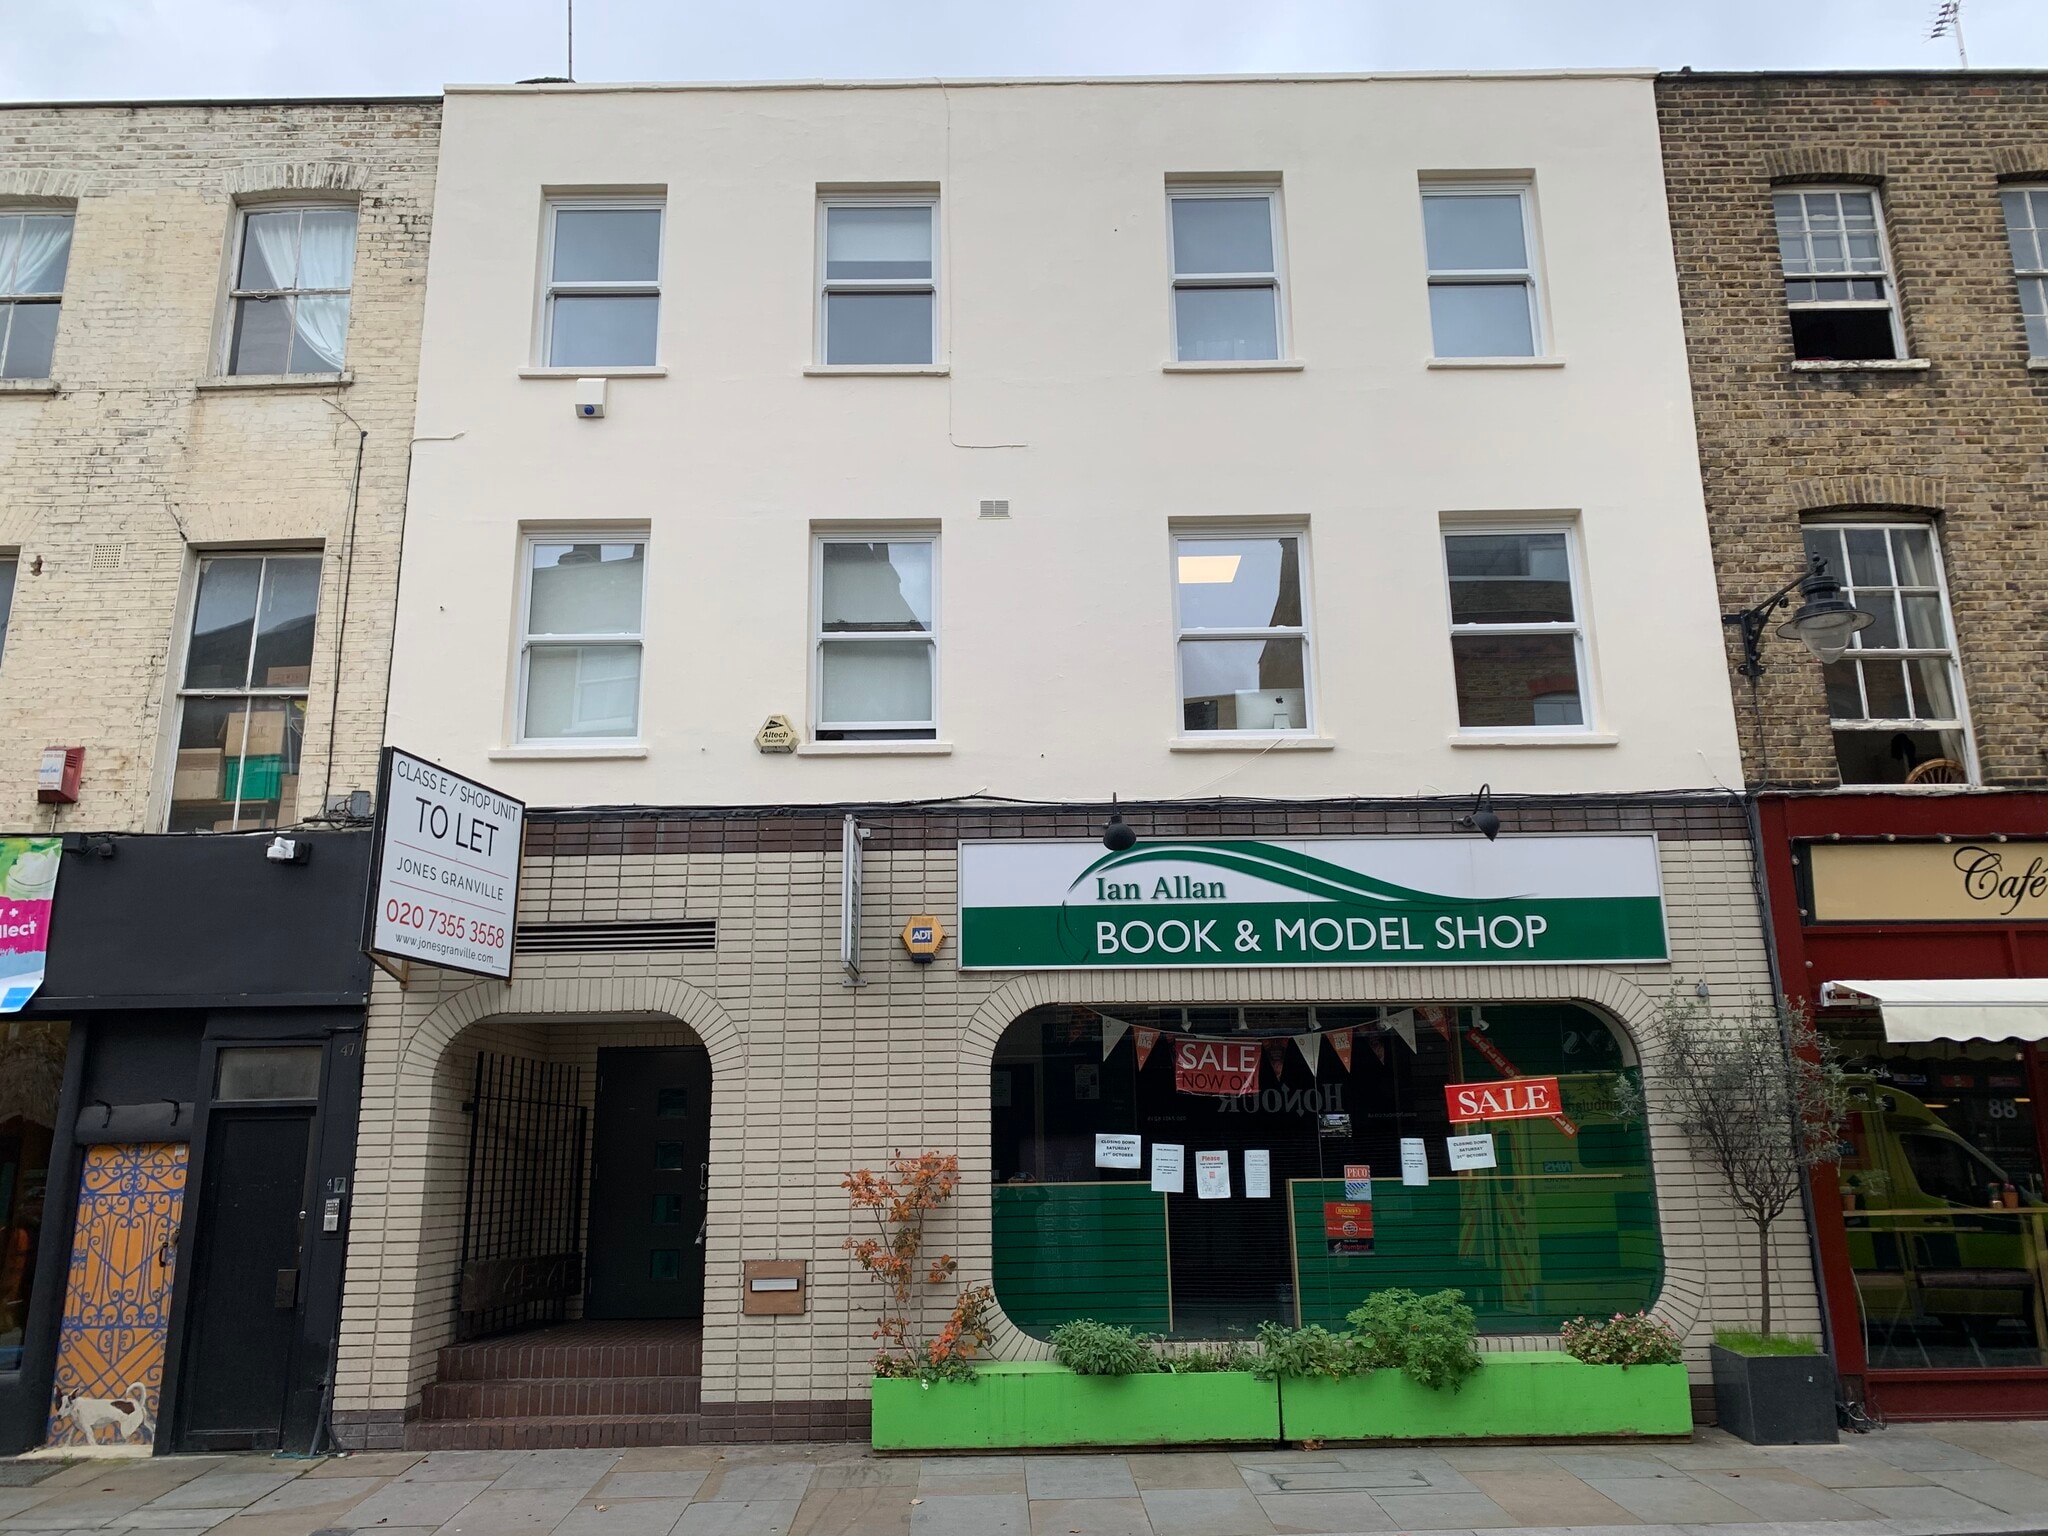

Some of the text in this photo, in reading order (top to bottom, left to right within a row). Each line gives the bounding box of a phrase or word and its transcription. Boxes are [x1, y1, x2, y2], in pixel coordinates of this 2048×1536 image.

[397, 760, 437, 790] CLASS
[440, 777, 448, 795] E
[460, 785, 490, 812] SHOP
[492, 800, 518, 822] UNIT
[416, 796, 500, 857] TO LET
[396, 856, 504, 901] JONES GRANVILLE
[1096, 876, 1226, 900] Ian Allan
[1954, 846, 2048, 916] Café
[386, 898, 504, 948] 020 7355 3558
[912, 930, 932, 940] ADT
[1096, 916, 1548, 954] BOOK & MODEL SHOP
[395, 932, 494, 964] www.jonesgranville.com
[340, 1043, 355, 1057] 47
[1182, 1044, 1256, 1072] SALE
[1182, 1073, 1254, 1092] NOW ON
[1458, 1086, 1550, 1115] SALE
[1988, 1100, 2018, 1118] 88
[326, 1178, 344, 1191] 47
[1347, 1168, 1368, 1178] PECO
